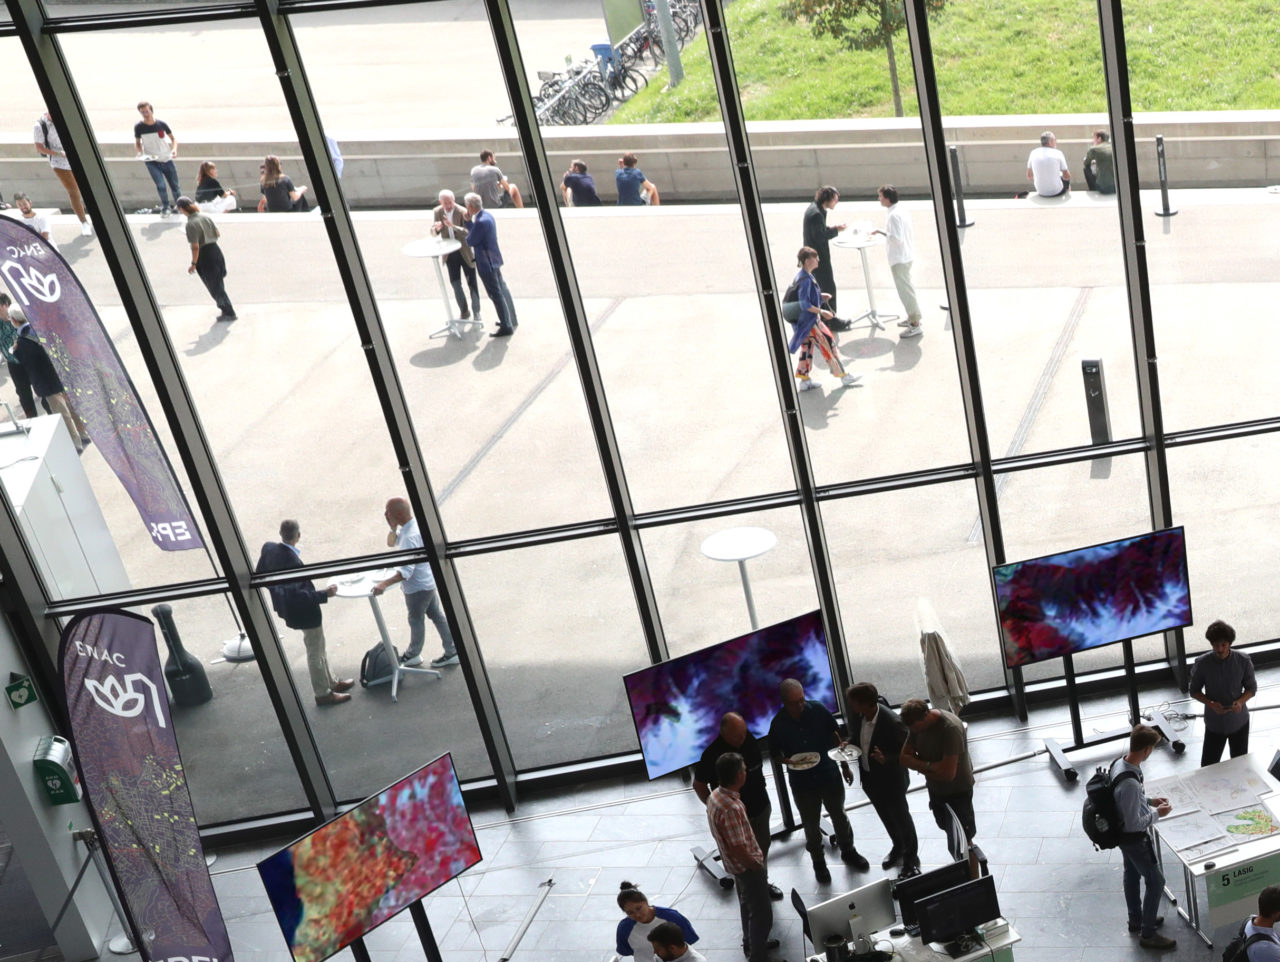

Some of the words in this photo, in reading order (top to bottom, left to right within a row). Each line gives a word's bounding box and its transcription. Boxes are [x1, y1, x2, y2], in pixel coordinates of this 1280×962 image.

[75, 641, 126, 668] ENAC
[1222, 873, 1231, 887] 5
[1233, 866, 1254, 878] LASIG
